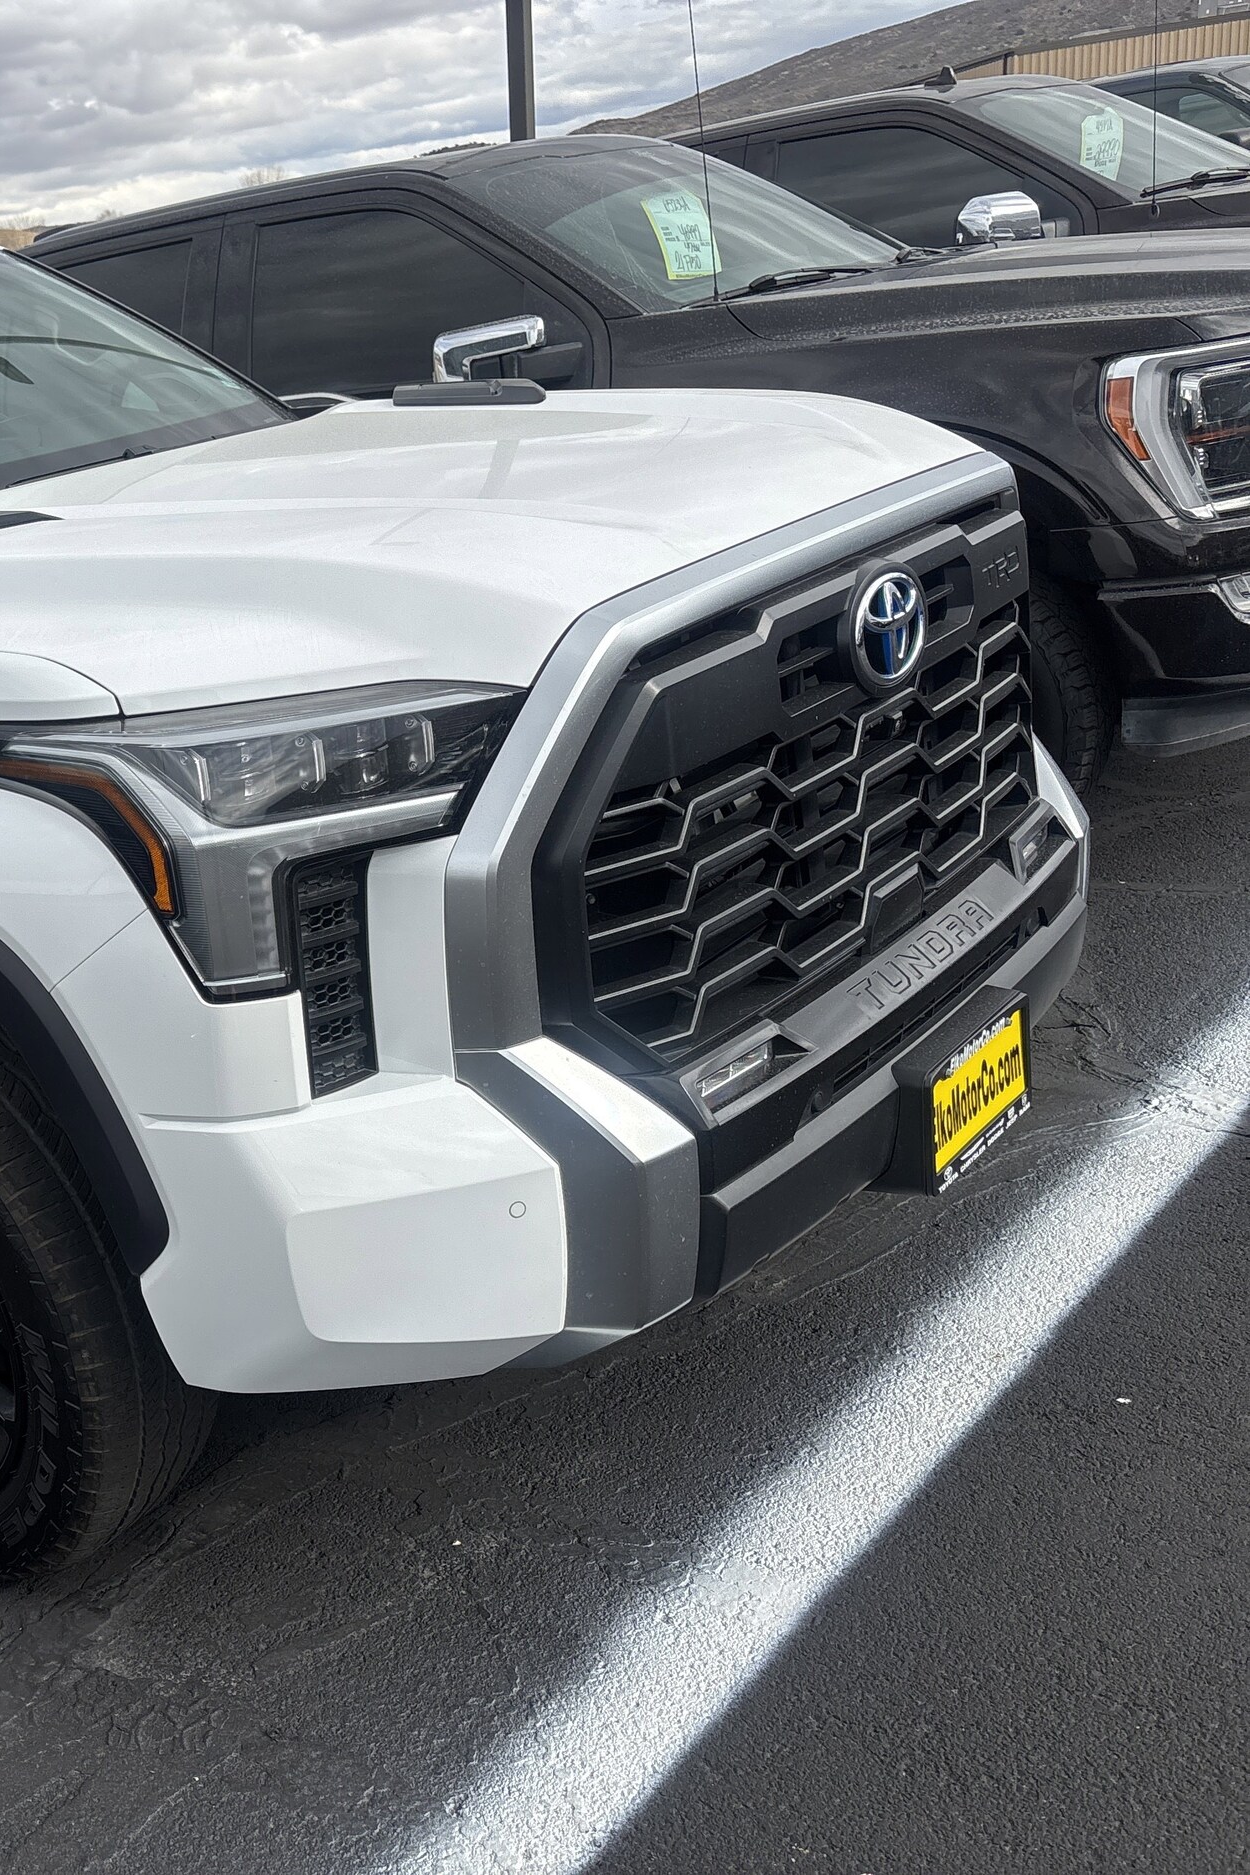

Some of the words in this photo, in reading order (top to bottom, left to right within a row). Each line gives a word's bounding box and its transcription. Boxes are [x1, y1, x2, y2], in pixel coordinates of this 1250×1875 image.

[981, 546, 1020, 588] TRD
[845, 899, 995, 1010] TUNDRA
[950, 1016, 1006, 1070] ElkoMotorCo.com
[938, 1171, 959, 1194] TOYOTA
[959, 1144, 986, 1173] CHRYSLER
[986, 1126, 1005, 1147] DODGE
[1018, 1101, 1031, 1117] RAM
